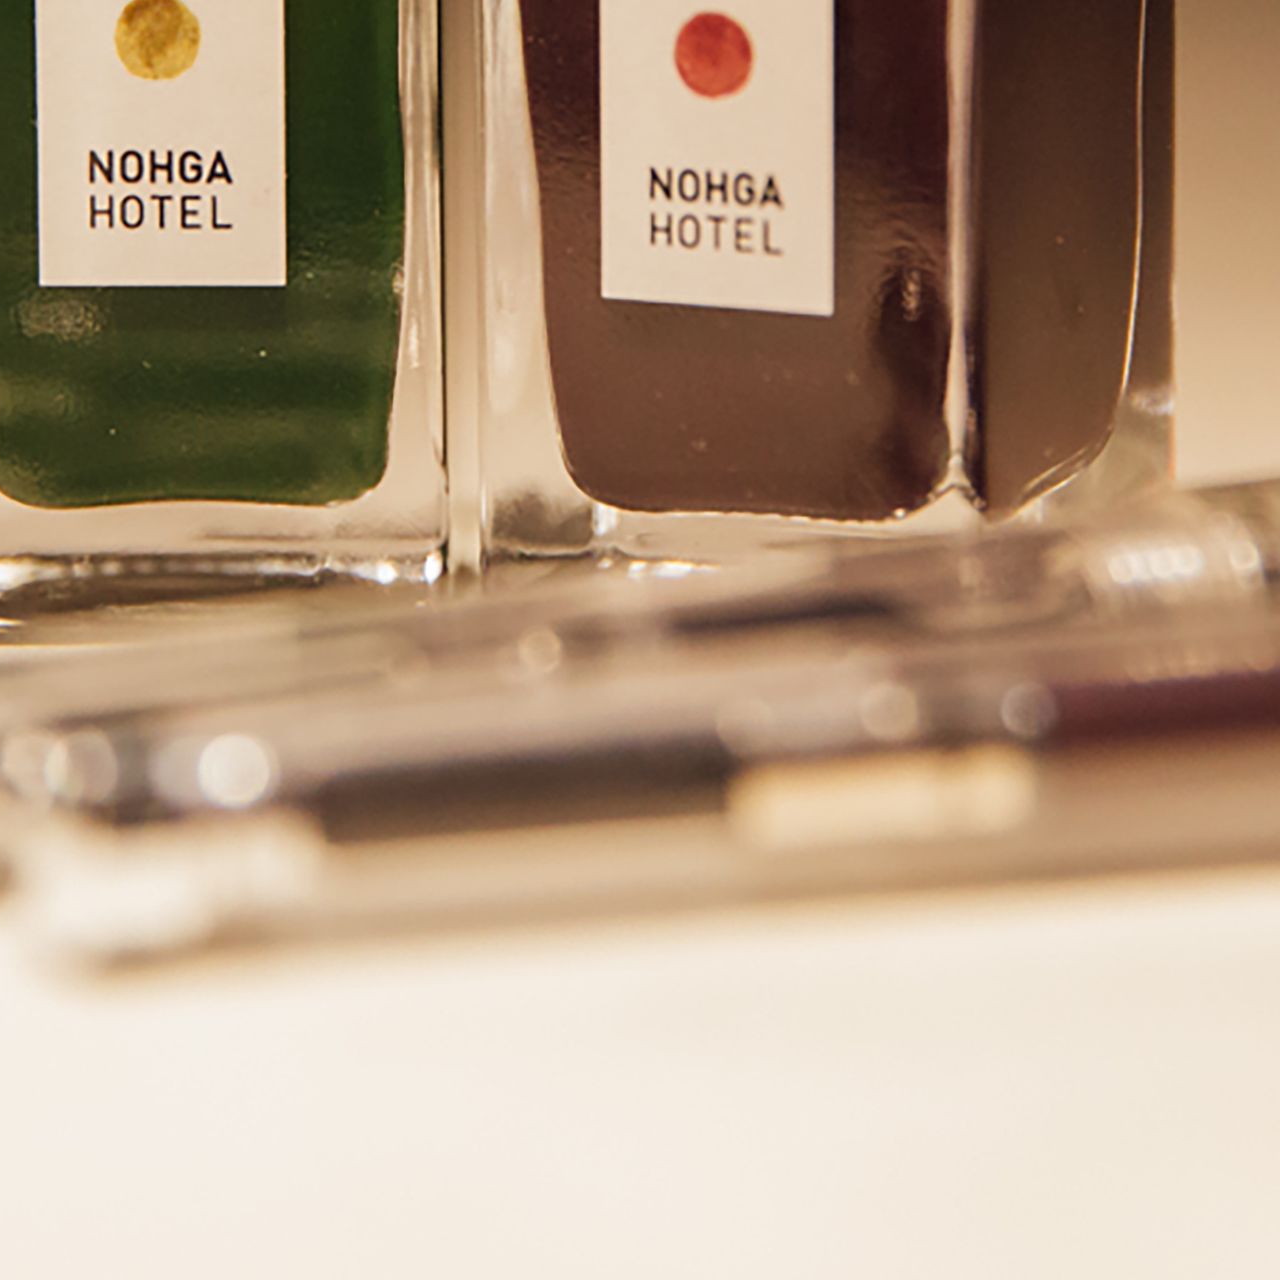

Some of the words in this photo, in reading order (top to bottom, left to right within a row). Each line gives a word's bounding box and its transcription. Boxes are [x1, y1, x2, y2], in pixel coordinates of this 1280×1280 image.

[88, 149, 234, 185] NOHGA
[648, 166, 785, 210] NOHGA
[89, 193, 234, 230] HOTEL
[649, 211, 784, 257] HOTEL
